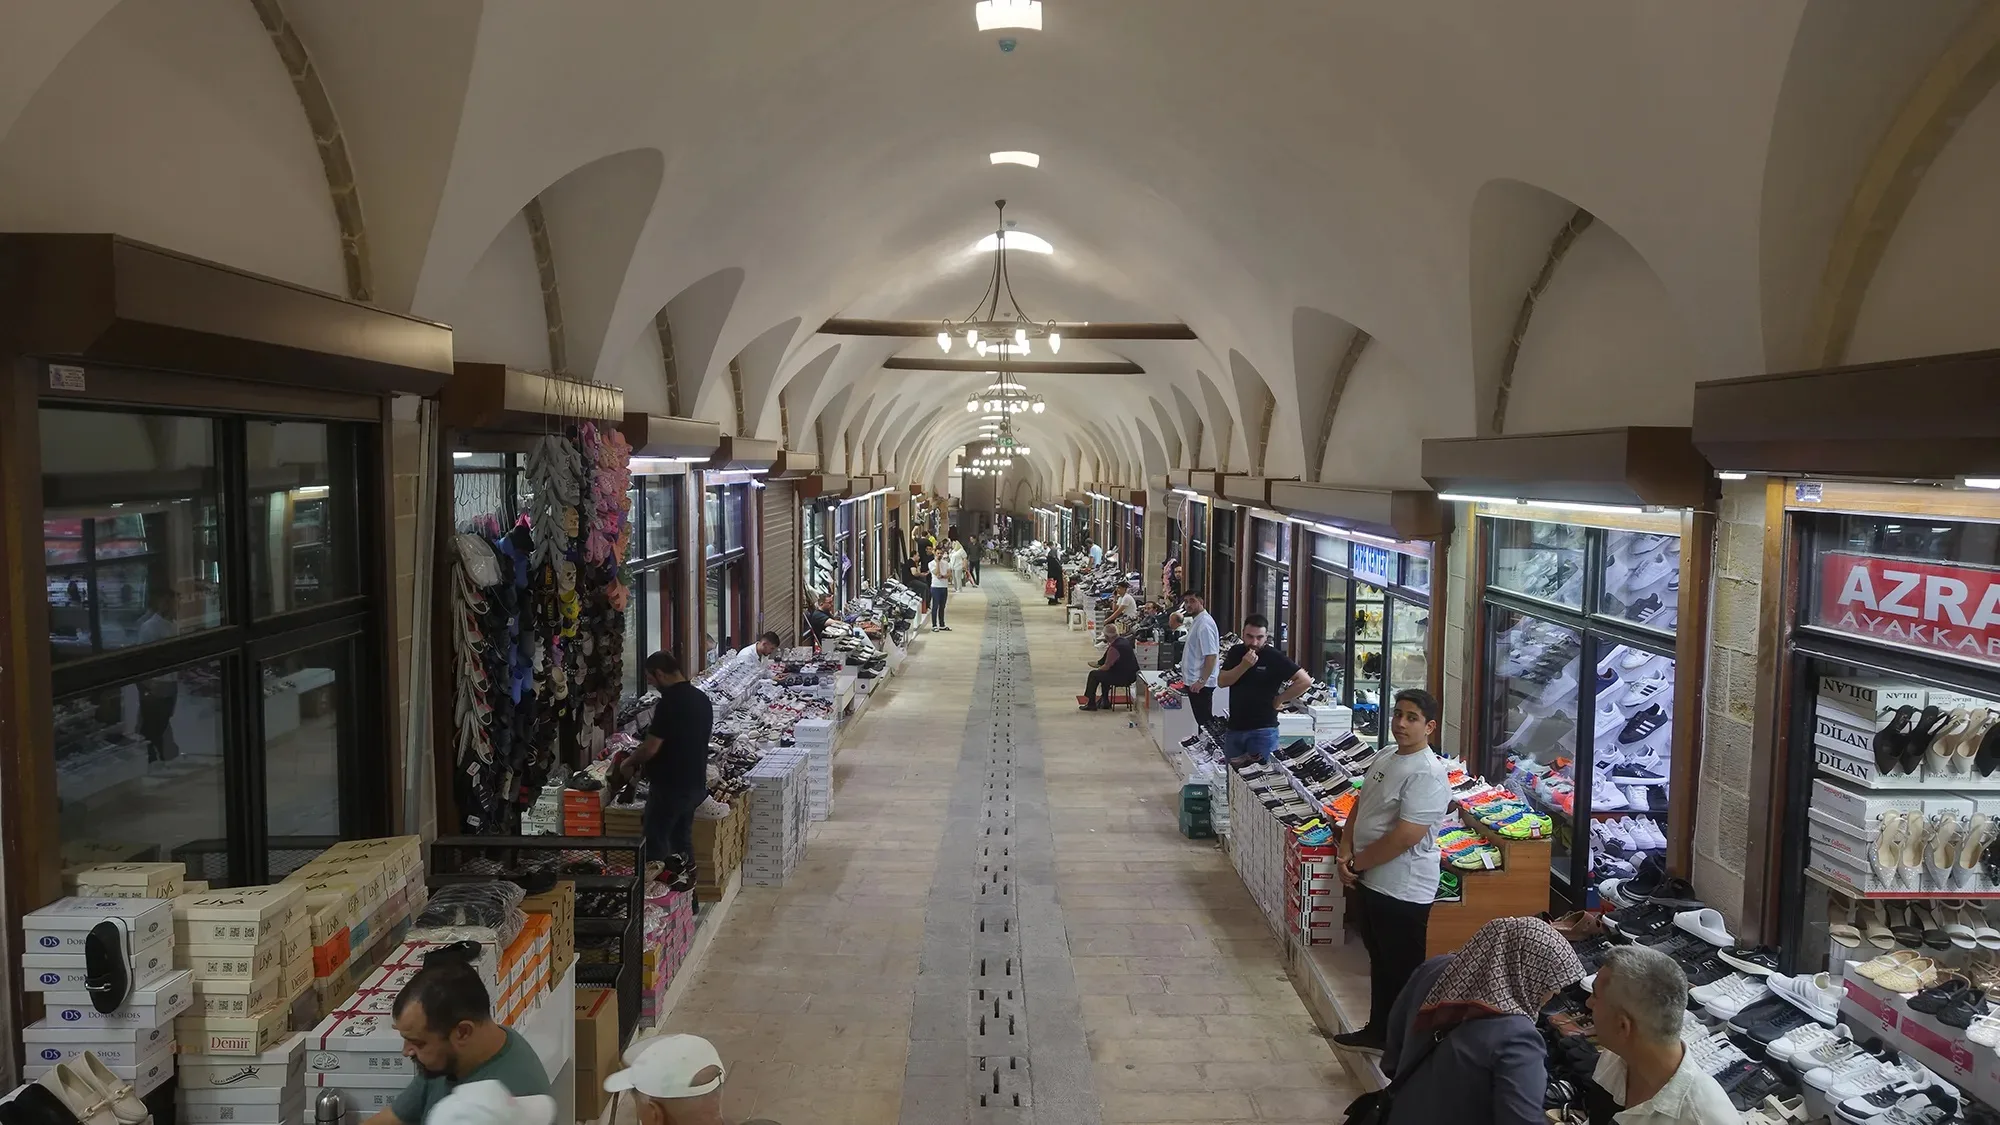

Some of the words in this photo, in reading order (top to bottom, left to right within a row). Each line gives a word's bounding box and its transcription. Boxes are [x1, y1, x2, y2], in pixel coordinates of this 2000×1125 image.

[1837, 565, 2000, 631] AZRA
[1838, 611, 2000, 657] AYAKKAB
[1819, 722, 1869, 750] DİLAN
[1818, 751, 1869, 780] DİLAN
[211, 1037, 251, 1049] Demir
